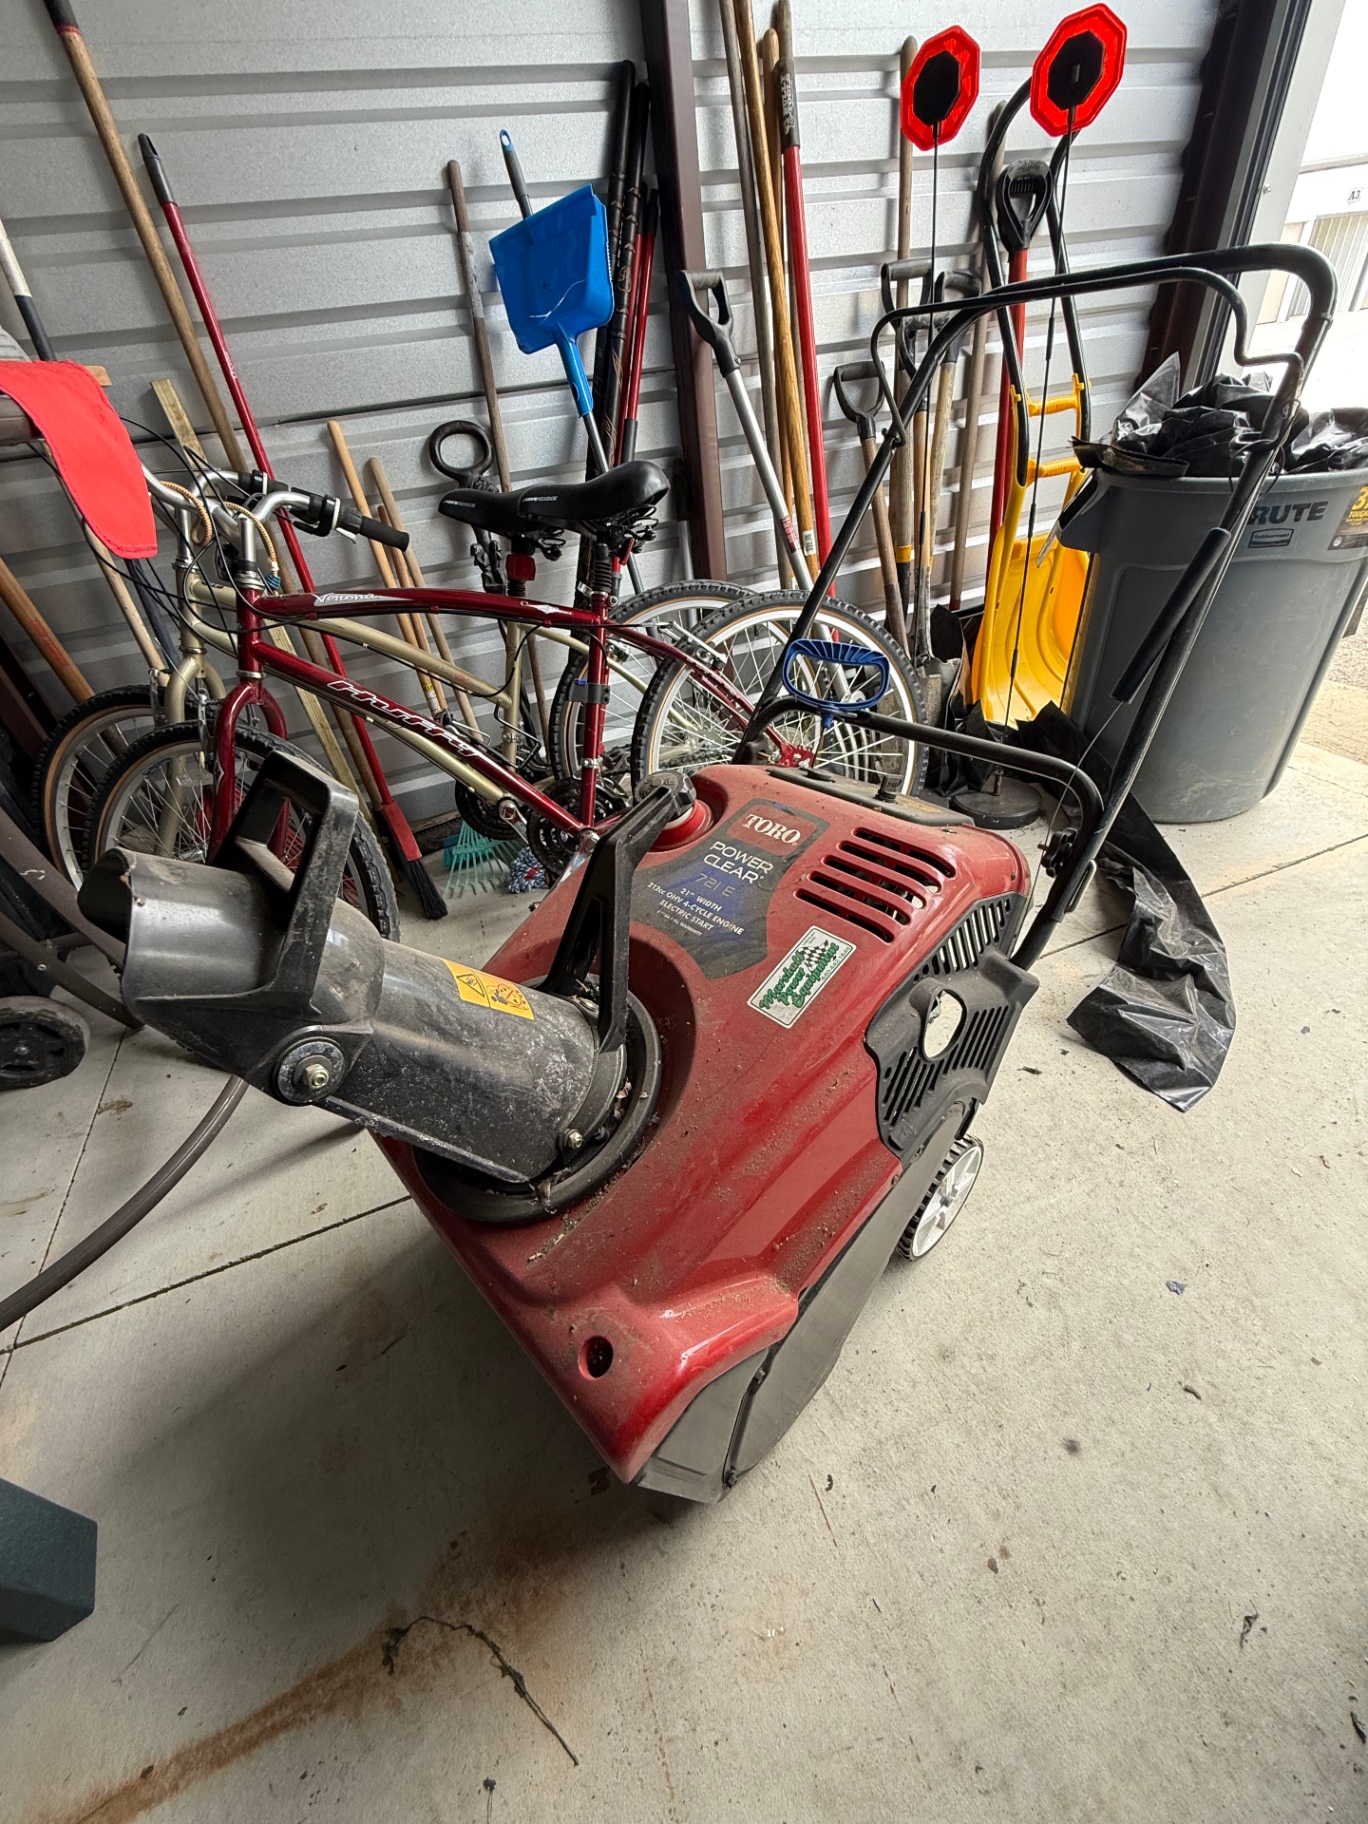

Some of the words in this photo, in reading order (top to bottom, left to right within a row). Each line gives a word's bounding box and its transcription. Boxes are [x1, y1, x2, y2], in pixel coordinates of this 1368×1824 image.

[1347, 190, 1362, 201] A3
[1246, 500, 1329, 526] RUTE
[326, 680, 478, 757] Huffy
[742, 813, 801, 844] TORO
[703, 854, 759, 885] CLEAR
[709, 841, 774, 875] POWER
[695, 873, 722, 891] 721
[721, 885, 736, 898] E
[647, 881, 666, 895] 212cc
[666, 891, 684, 904] OHV
[682, 900, 714, 919] 4-CYCLE
[711, 914, 745, 936] ENGINE
[659, 899, 692, 920] ELECTRIC
[690, 916, 715, 931] START
[696, 895, 723, 912] WIDTH
[776, 966, 806, 1007] Power
[791, 942, 840, 1009] Equipment
